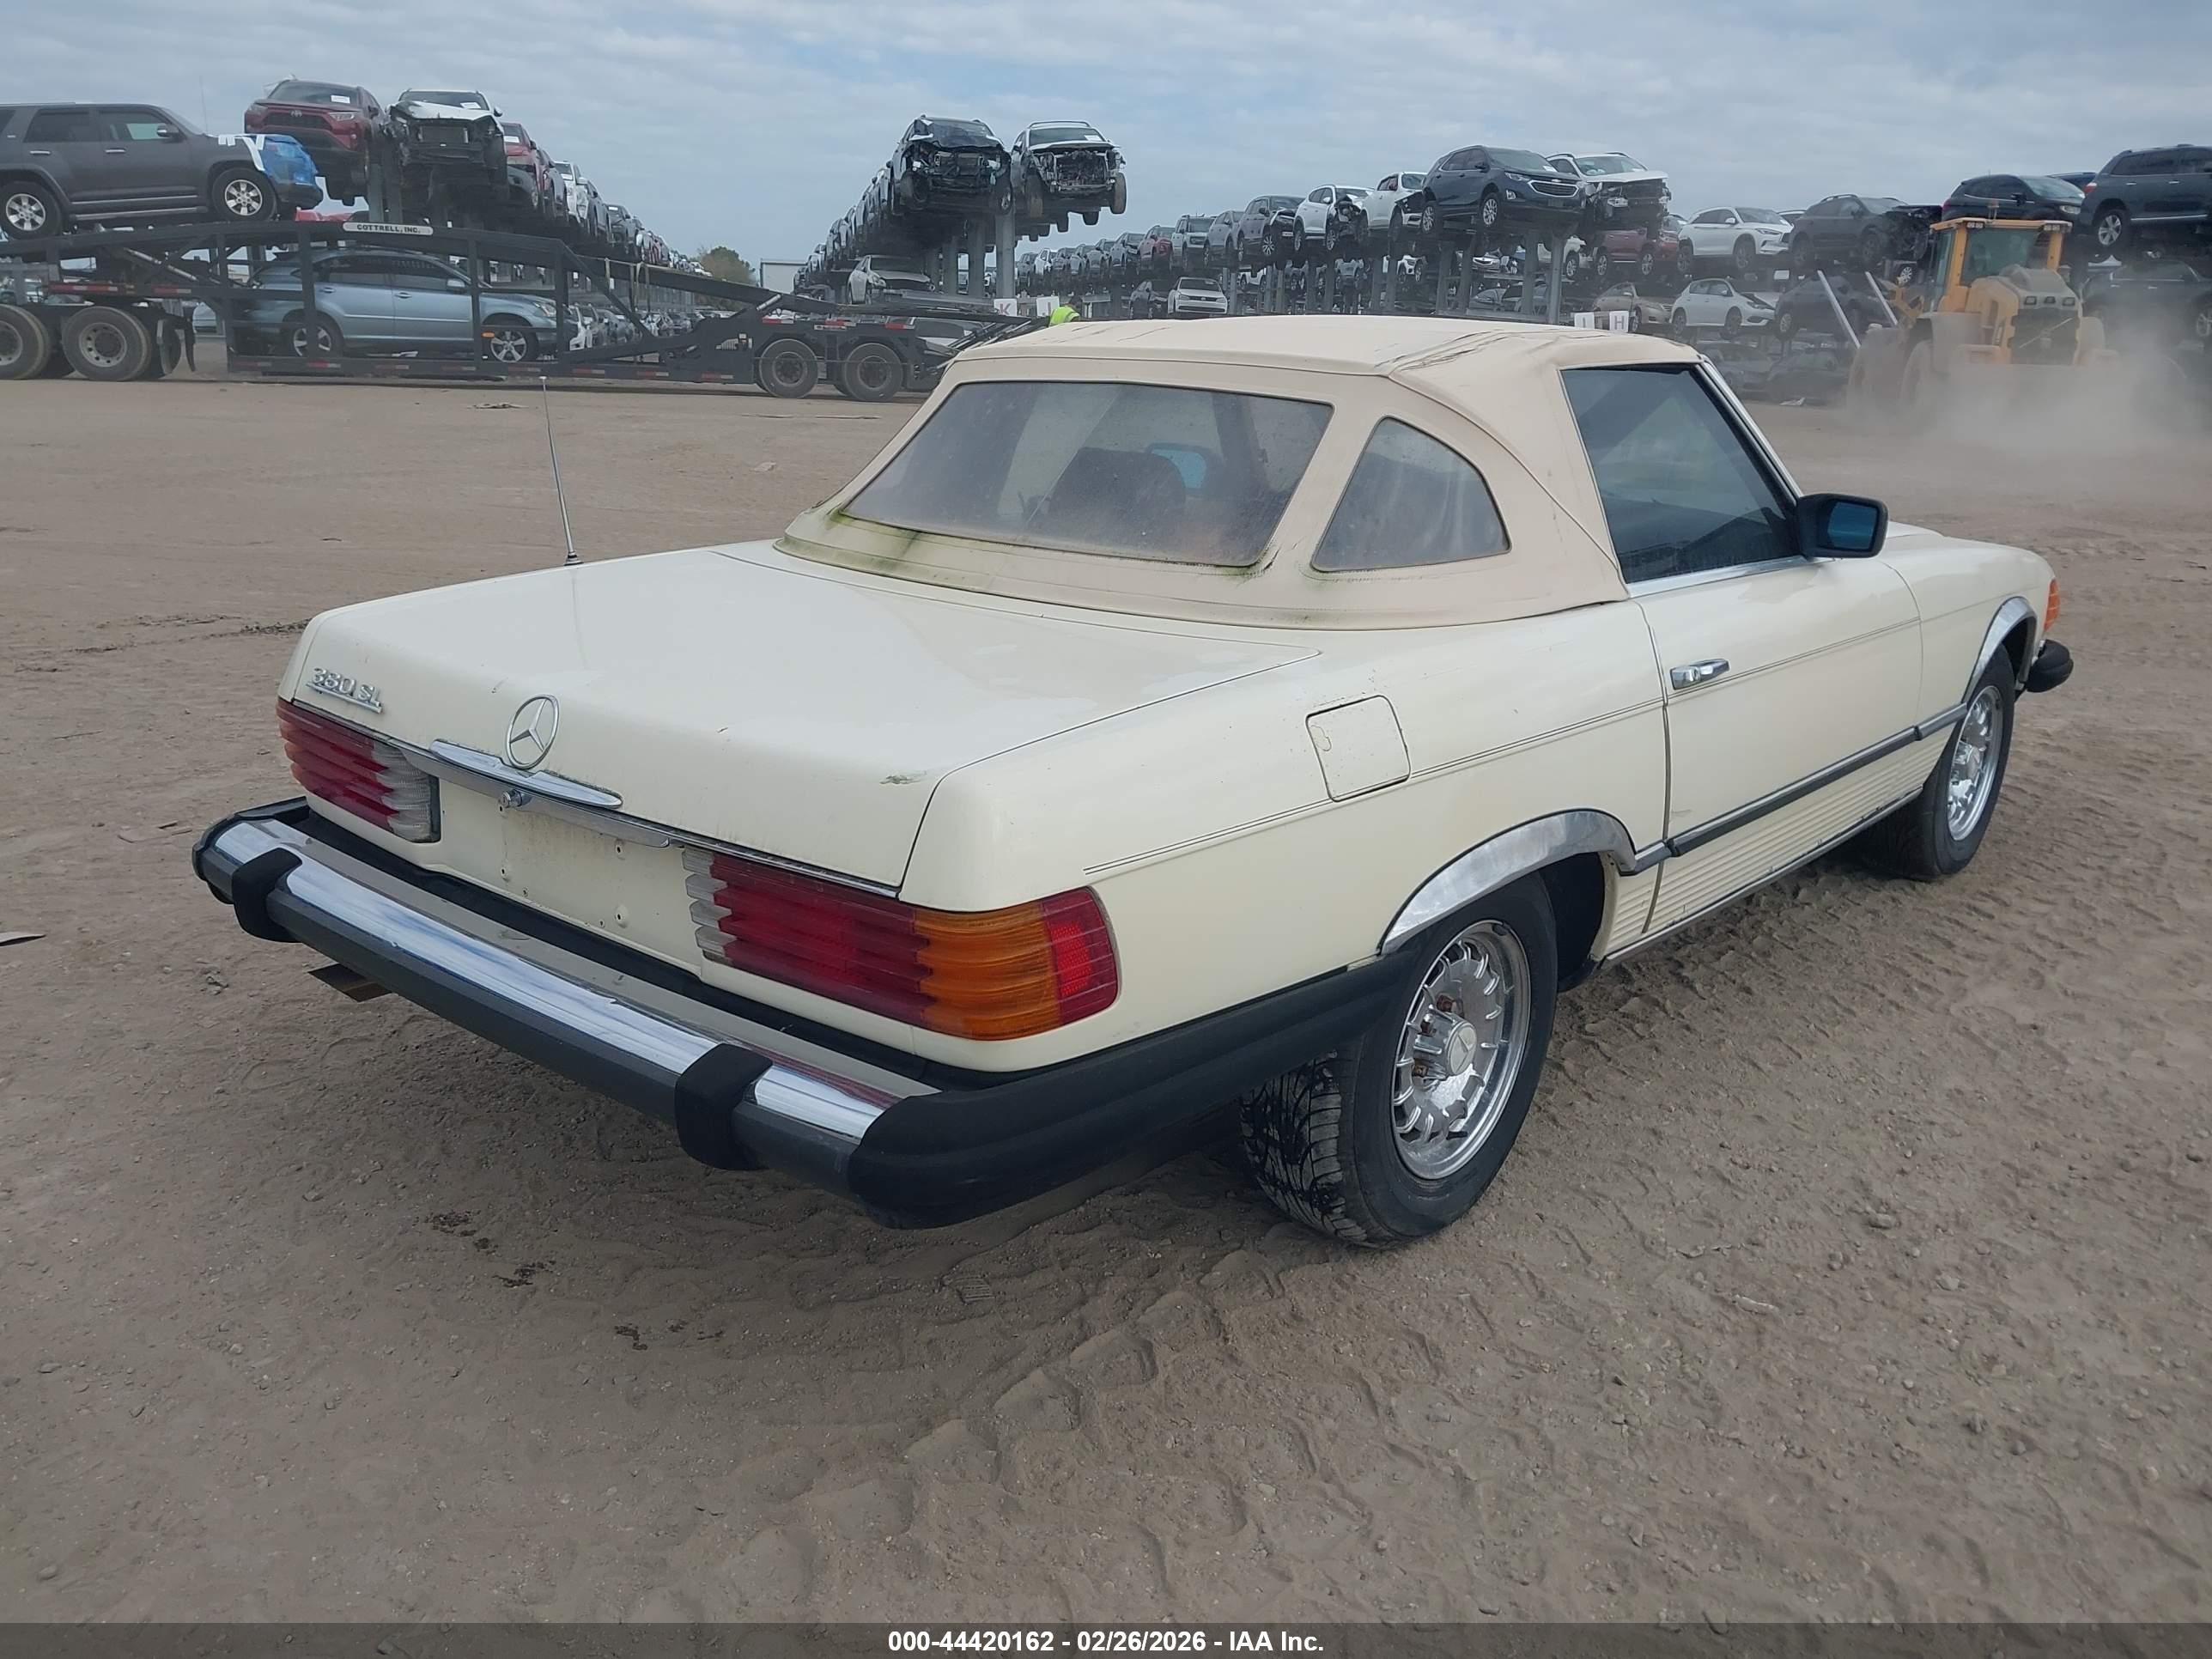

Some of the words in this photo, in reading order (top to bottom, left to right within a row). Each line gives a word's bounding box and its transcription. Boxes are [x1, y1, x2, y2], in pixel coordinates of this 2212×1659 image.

[356, 224, 403, 234] COTTRELL,
[1000, 303, 1011, 316] K
[1614, 315, 1625, 330] H
[313, 667, 356, 696] 380
[357, 684, 381, 708] SL
